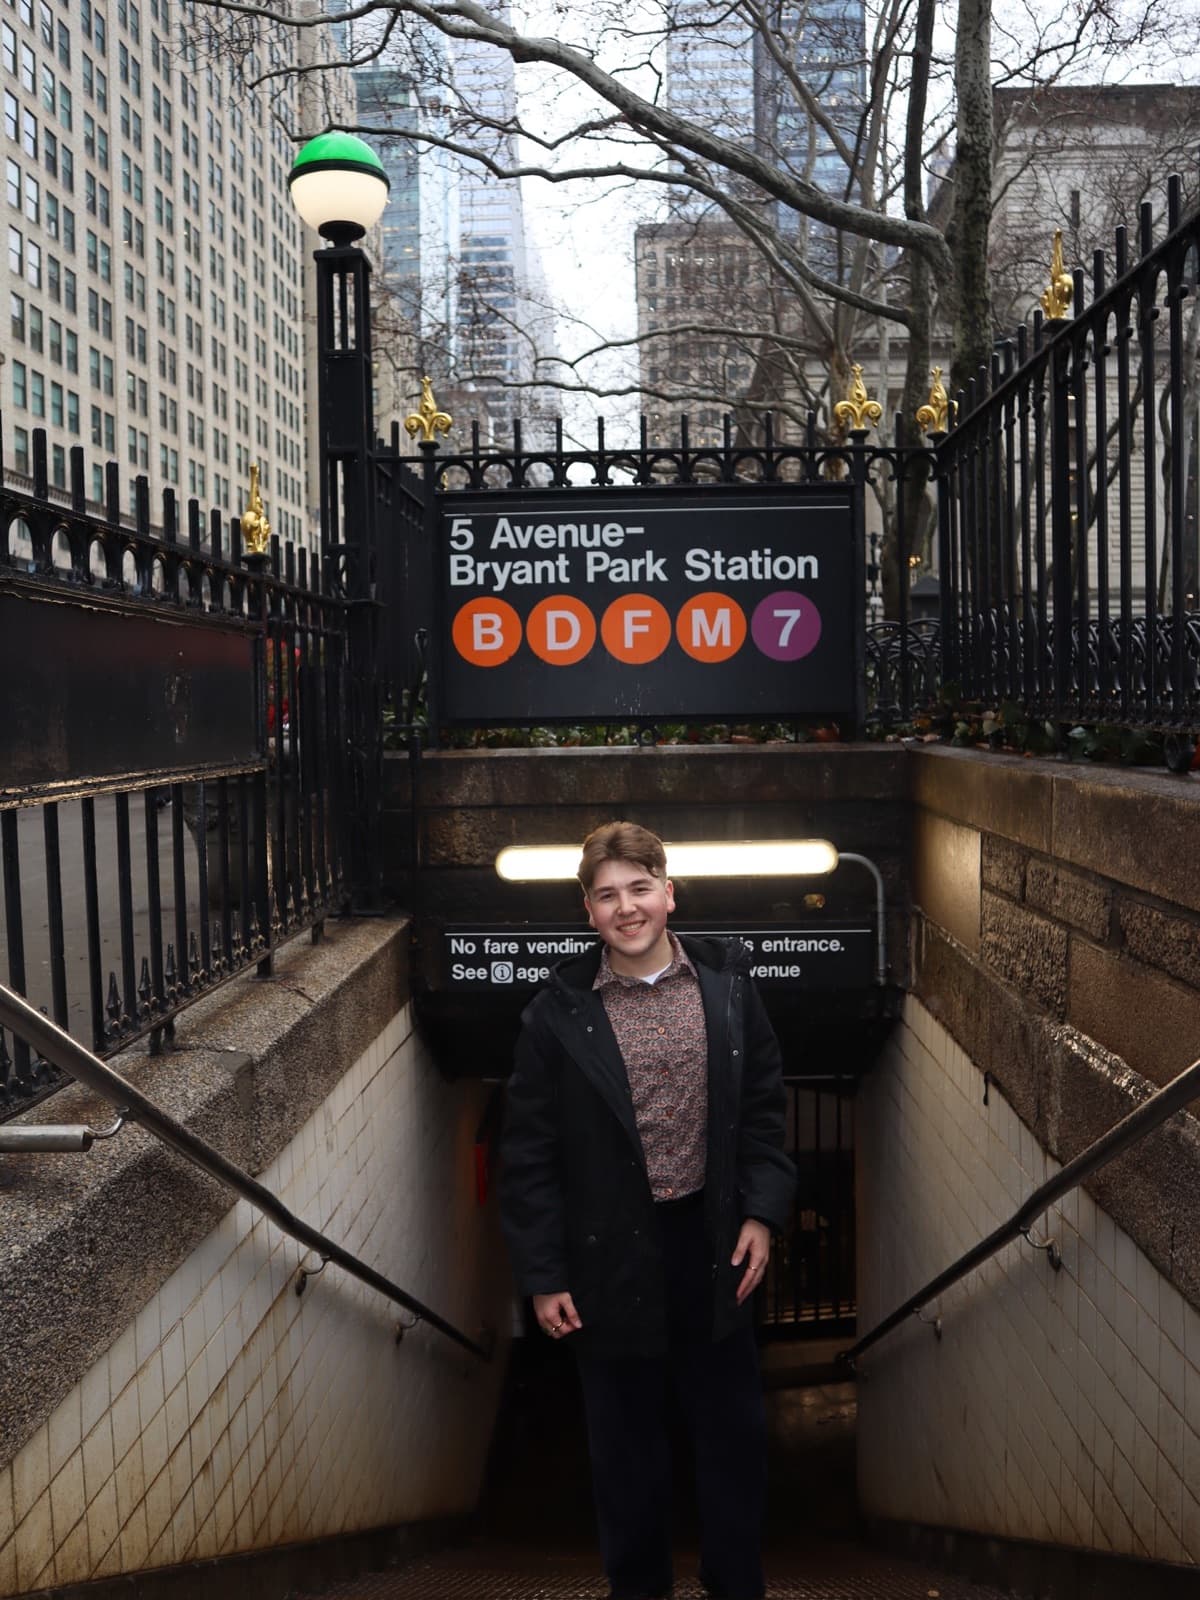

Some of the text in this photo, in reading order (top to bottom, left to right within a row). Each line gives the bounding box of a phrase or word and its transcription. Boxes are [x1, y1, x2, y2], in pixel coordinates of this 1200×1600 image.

[450, 517, 645, 550] 5 Avenue-
[450, 548, 819, 591] Bryant Park Station
[473, 608, 801, 650] B D F M 7
[451, 938, 476, 954] No
[483, 938, 519, 954] fare
[761, 937, 845, 952] entrance.
[452, 963, 801, 982] See age venue
